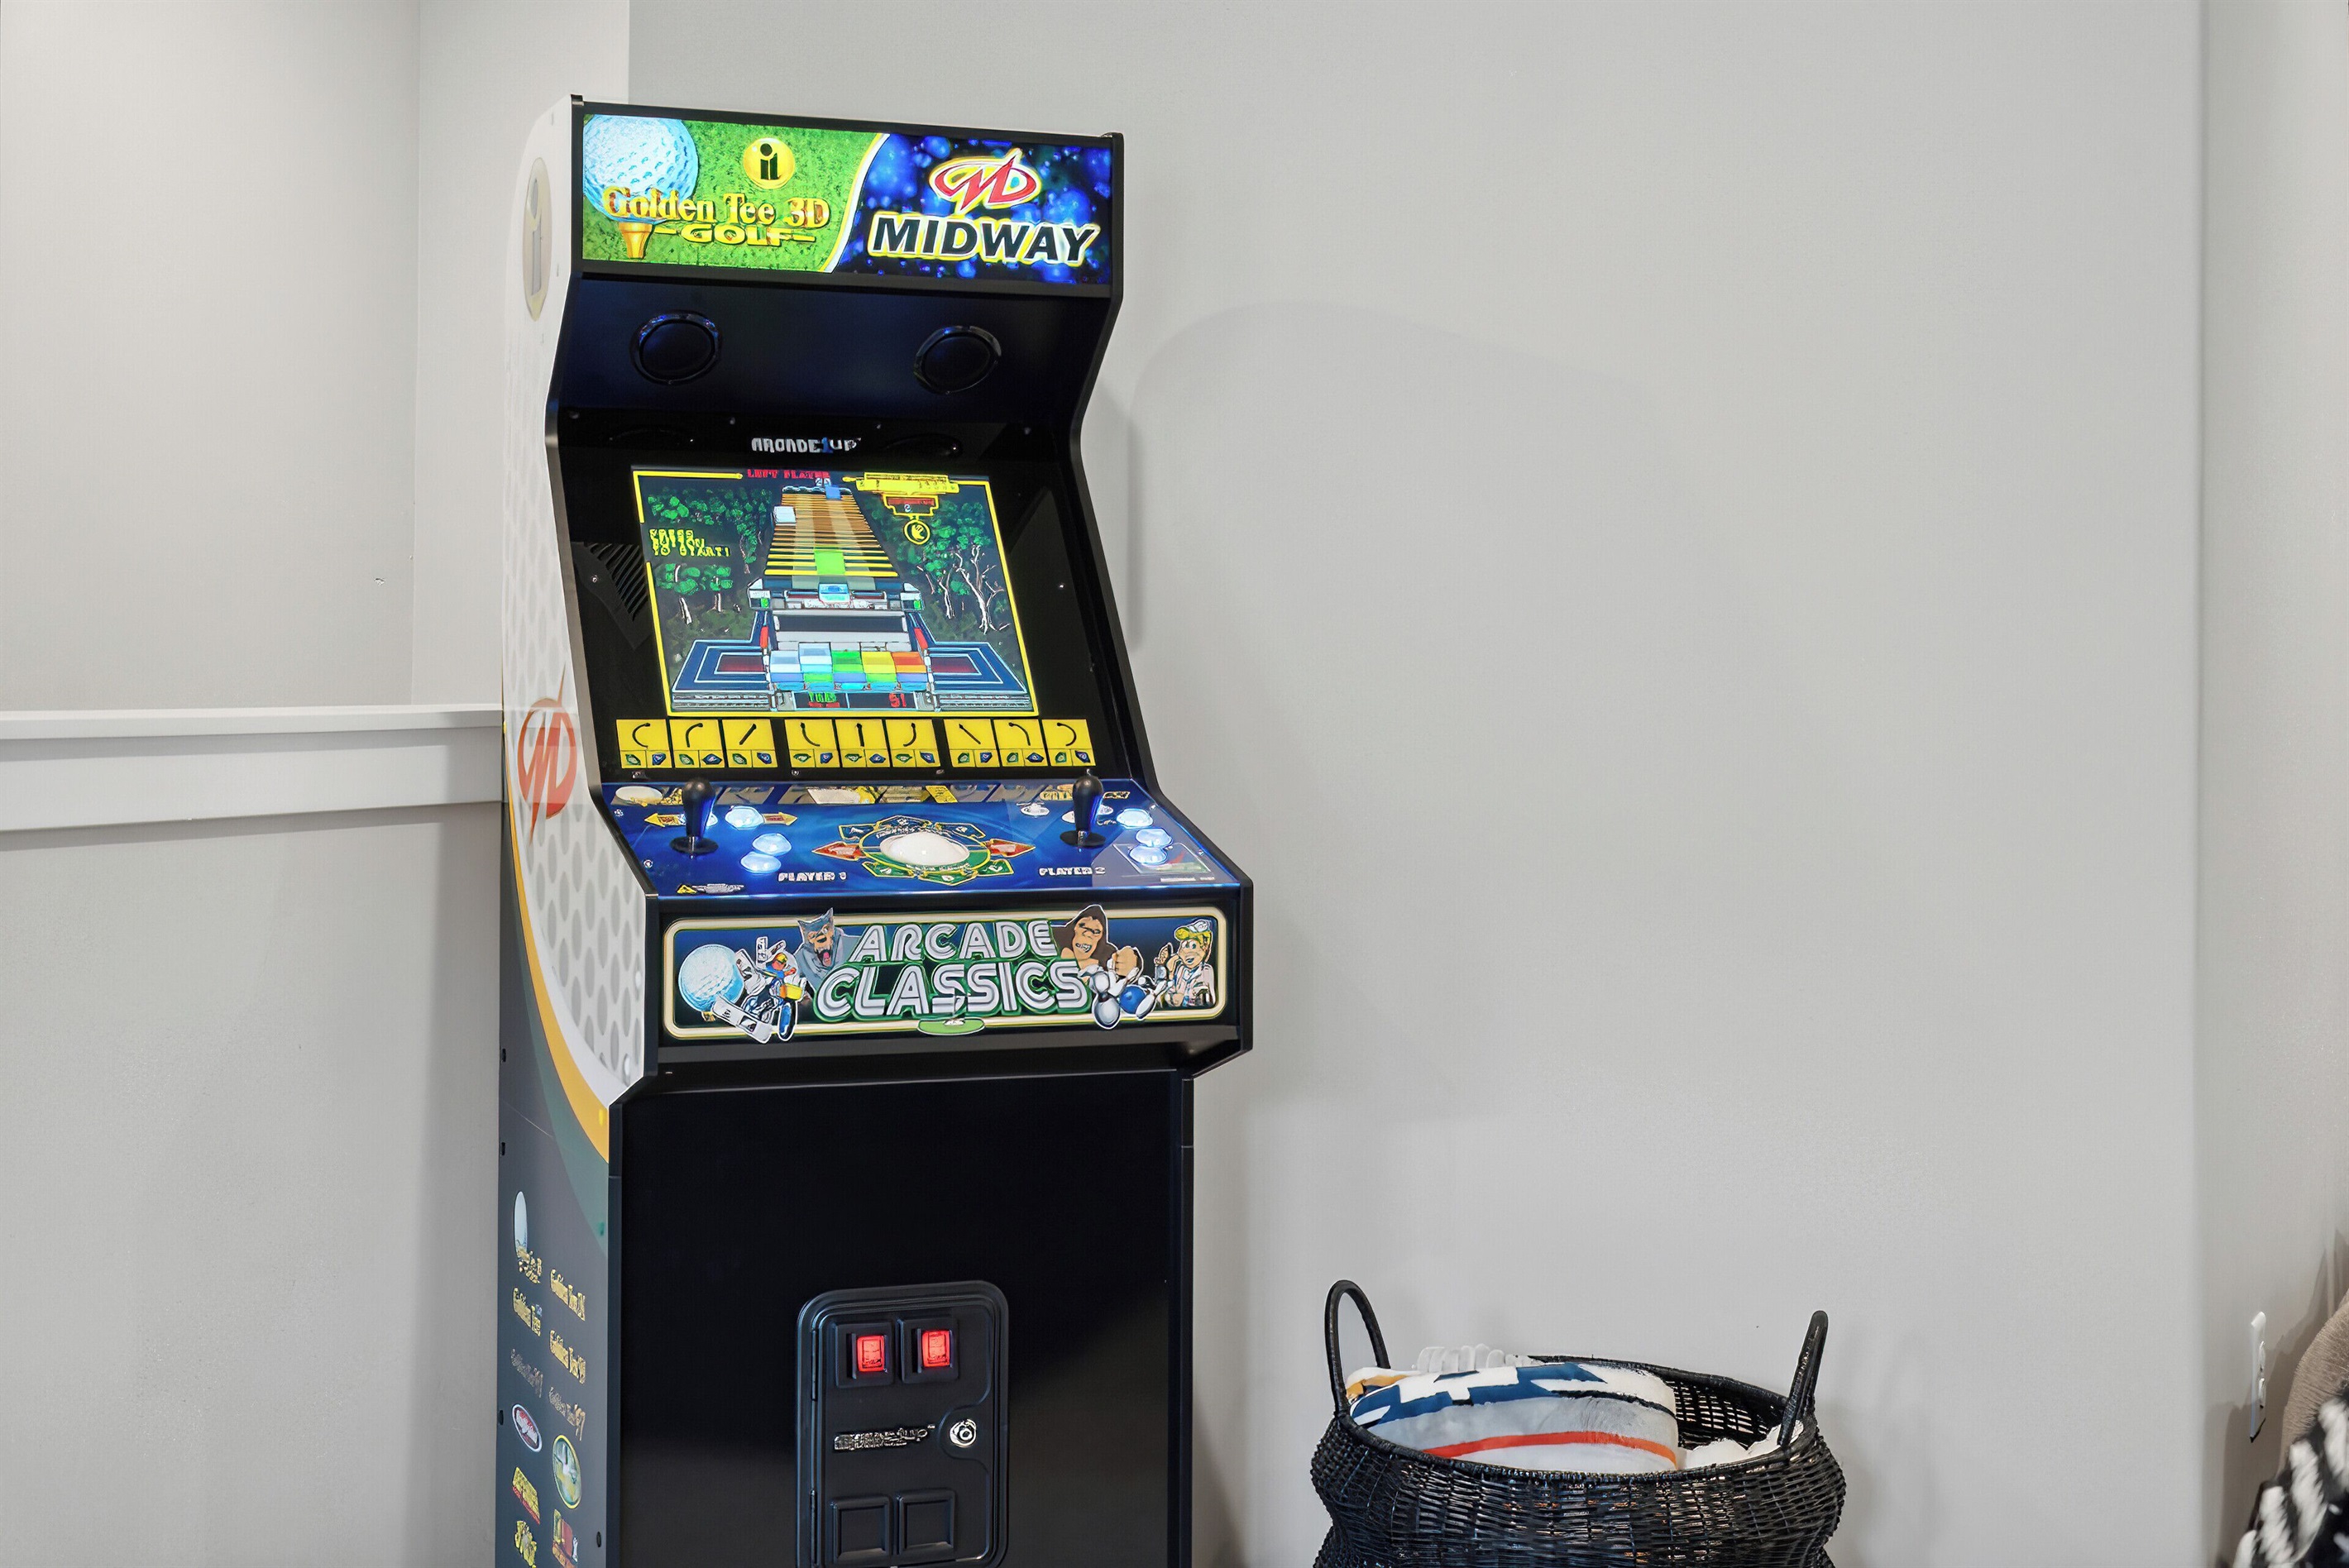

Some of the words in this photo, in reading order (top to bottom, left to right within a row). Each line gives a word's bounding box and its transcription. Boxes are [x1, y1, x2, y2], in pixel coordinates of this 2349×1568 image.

[602, 185, 716, 223] Golden
[723, 193, 776, 225] Tee
[784, 197, 830, 228] 3D
[680, 223, 792, 246] GOLF
[869, 213, 1099, 265] MIDWAY
[849, 920, 1058, 962] ARCADE
[816, 961, 1089, 1018] CLASSICS
